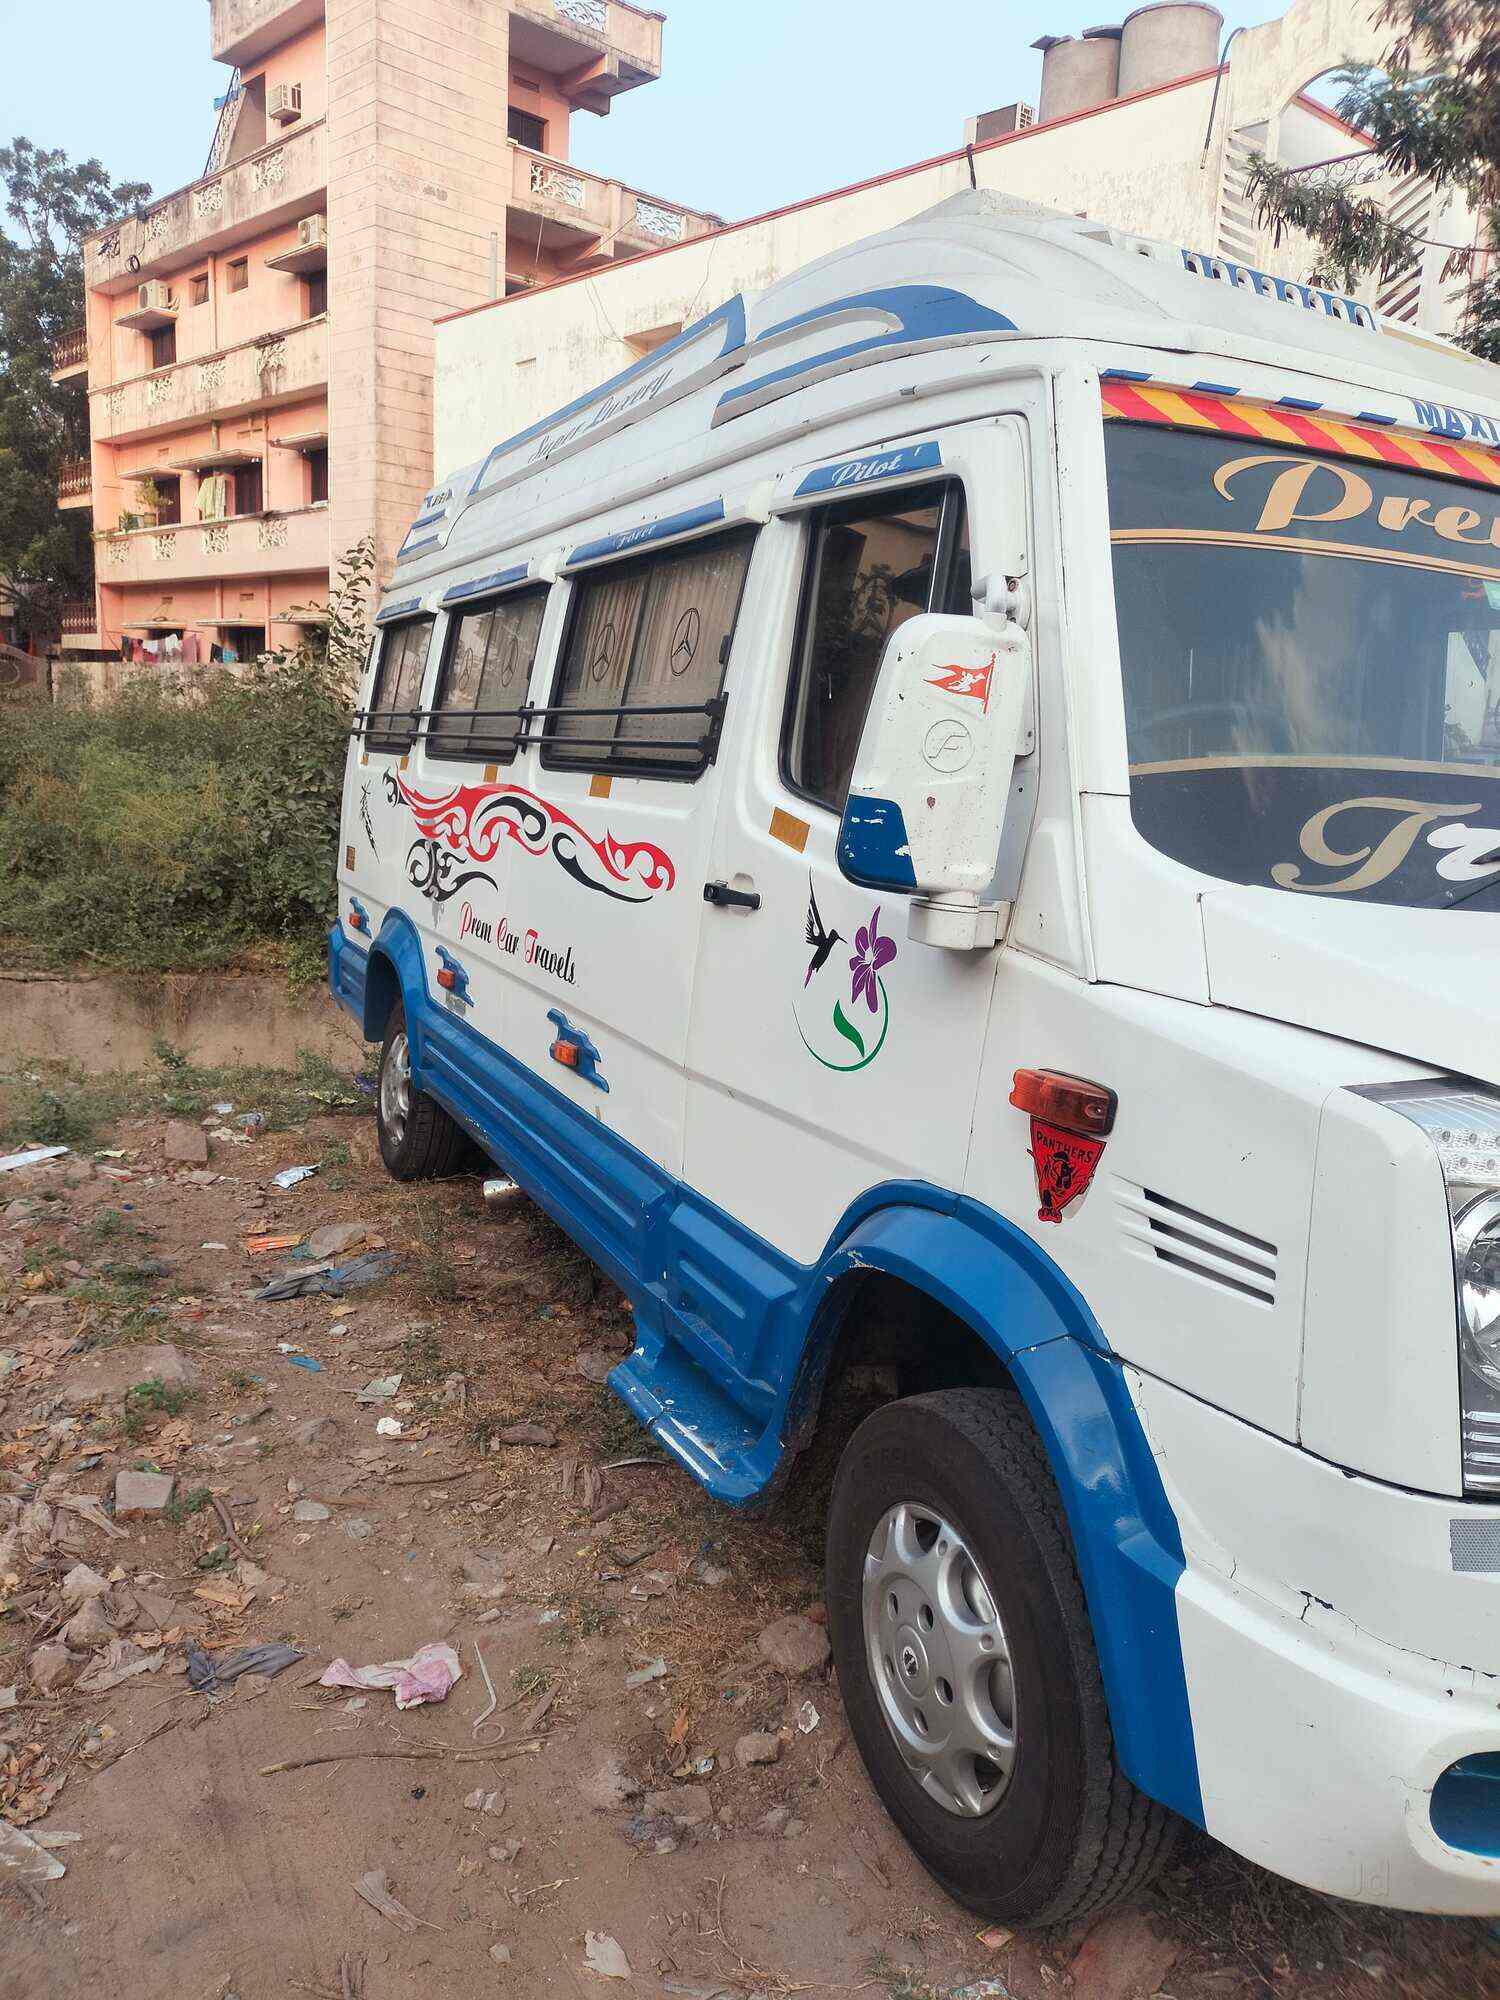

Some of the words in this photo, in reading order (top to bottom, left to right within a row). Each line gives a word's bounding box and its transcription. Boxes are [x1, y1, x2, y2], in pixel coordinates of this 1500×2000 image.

[832, 453, 904, 488] Pilot
[1212, 455, 1500, 549] Pre
[460, 901, 492, 943] Prem
[496, 917, 520, 955] Car
[1036, 1130, 1095, 1164] PANTHERS
